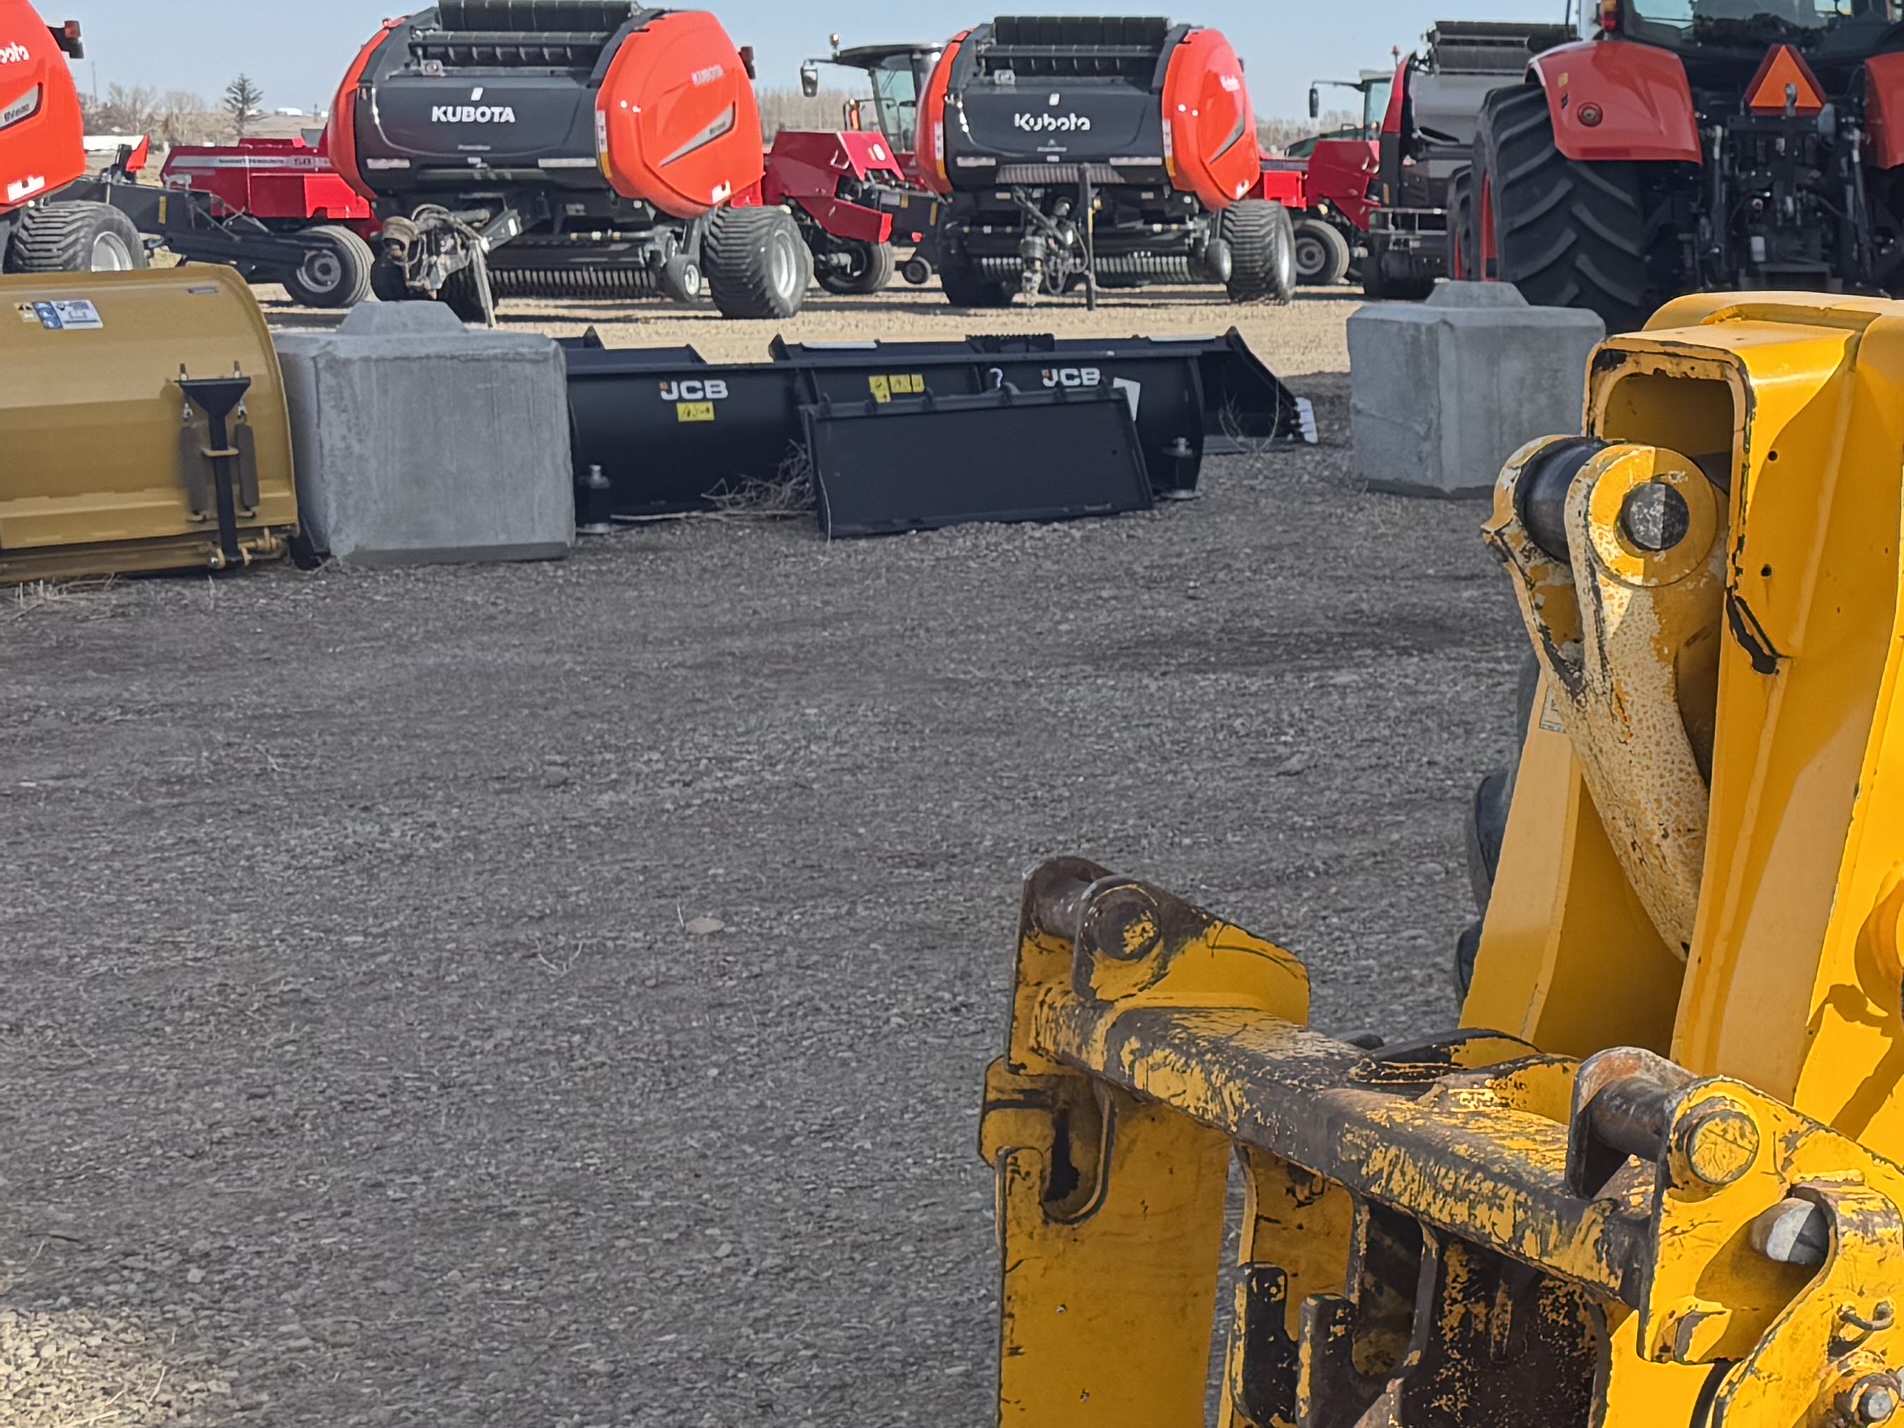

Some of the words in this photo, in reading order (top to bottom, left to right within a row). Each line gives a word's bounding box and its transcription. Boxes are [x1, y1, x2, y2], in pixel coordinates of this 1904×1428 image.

[431, 105, 516, 124] KUBOTA
[1013, 112, 1091, 132] Kubota
[1042, 367, 1101, 388] JCB
[660, 379, 729, 401] JCB
